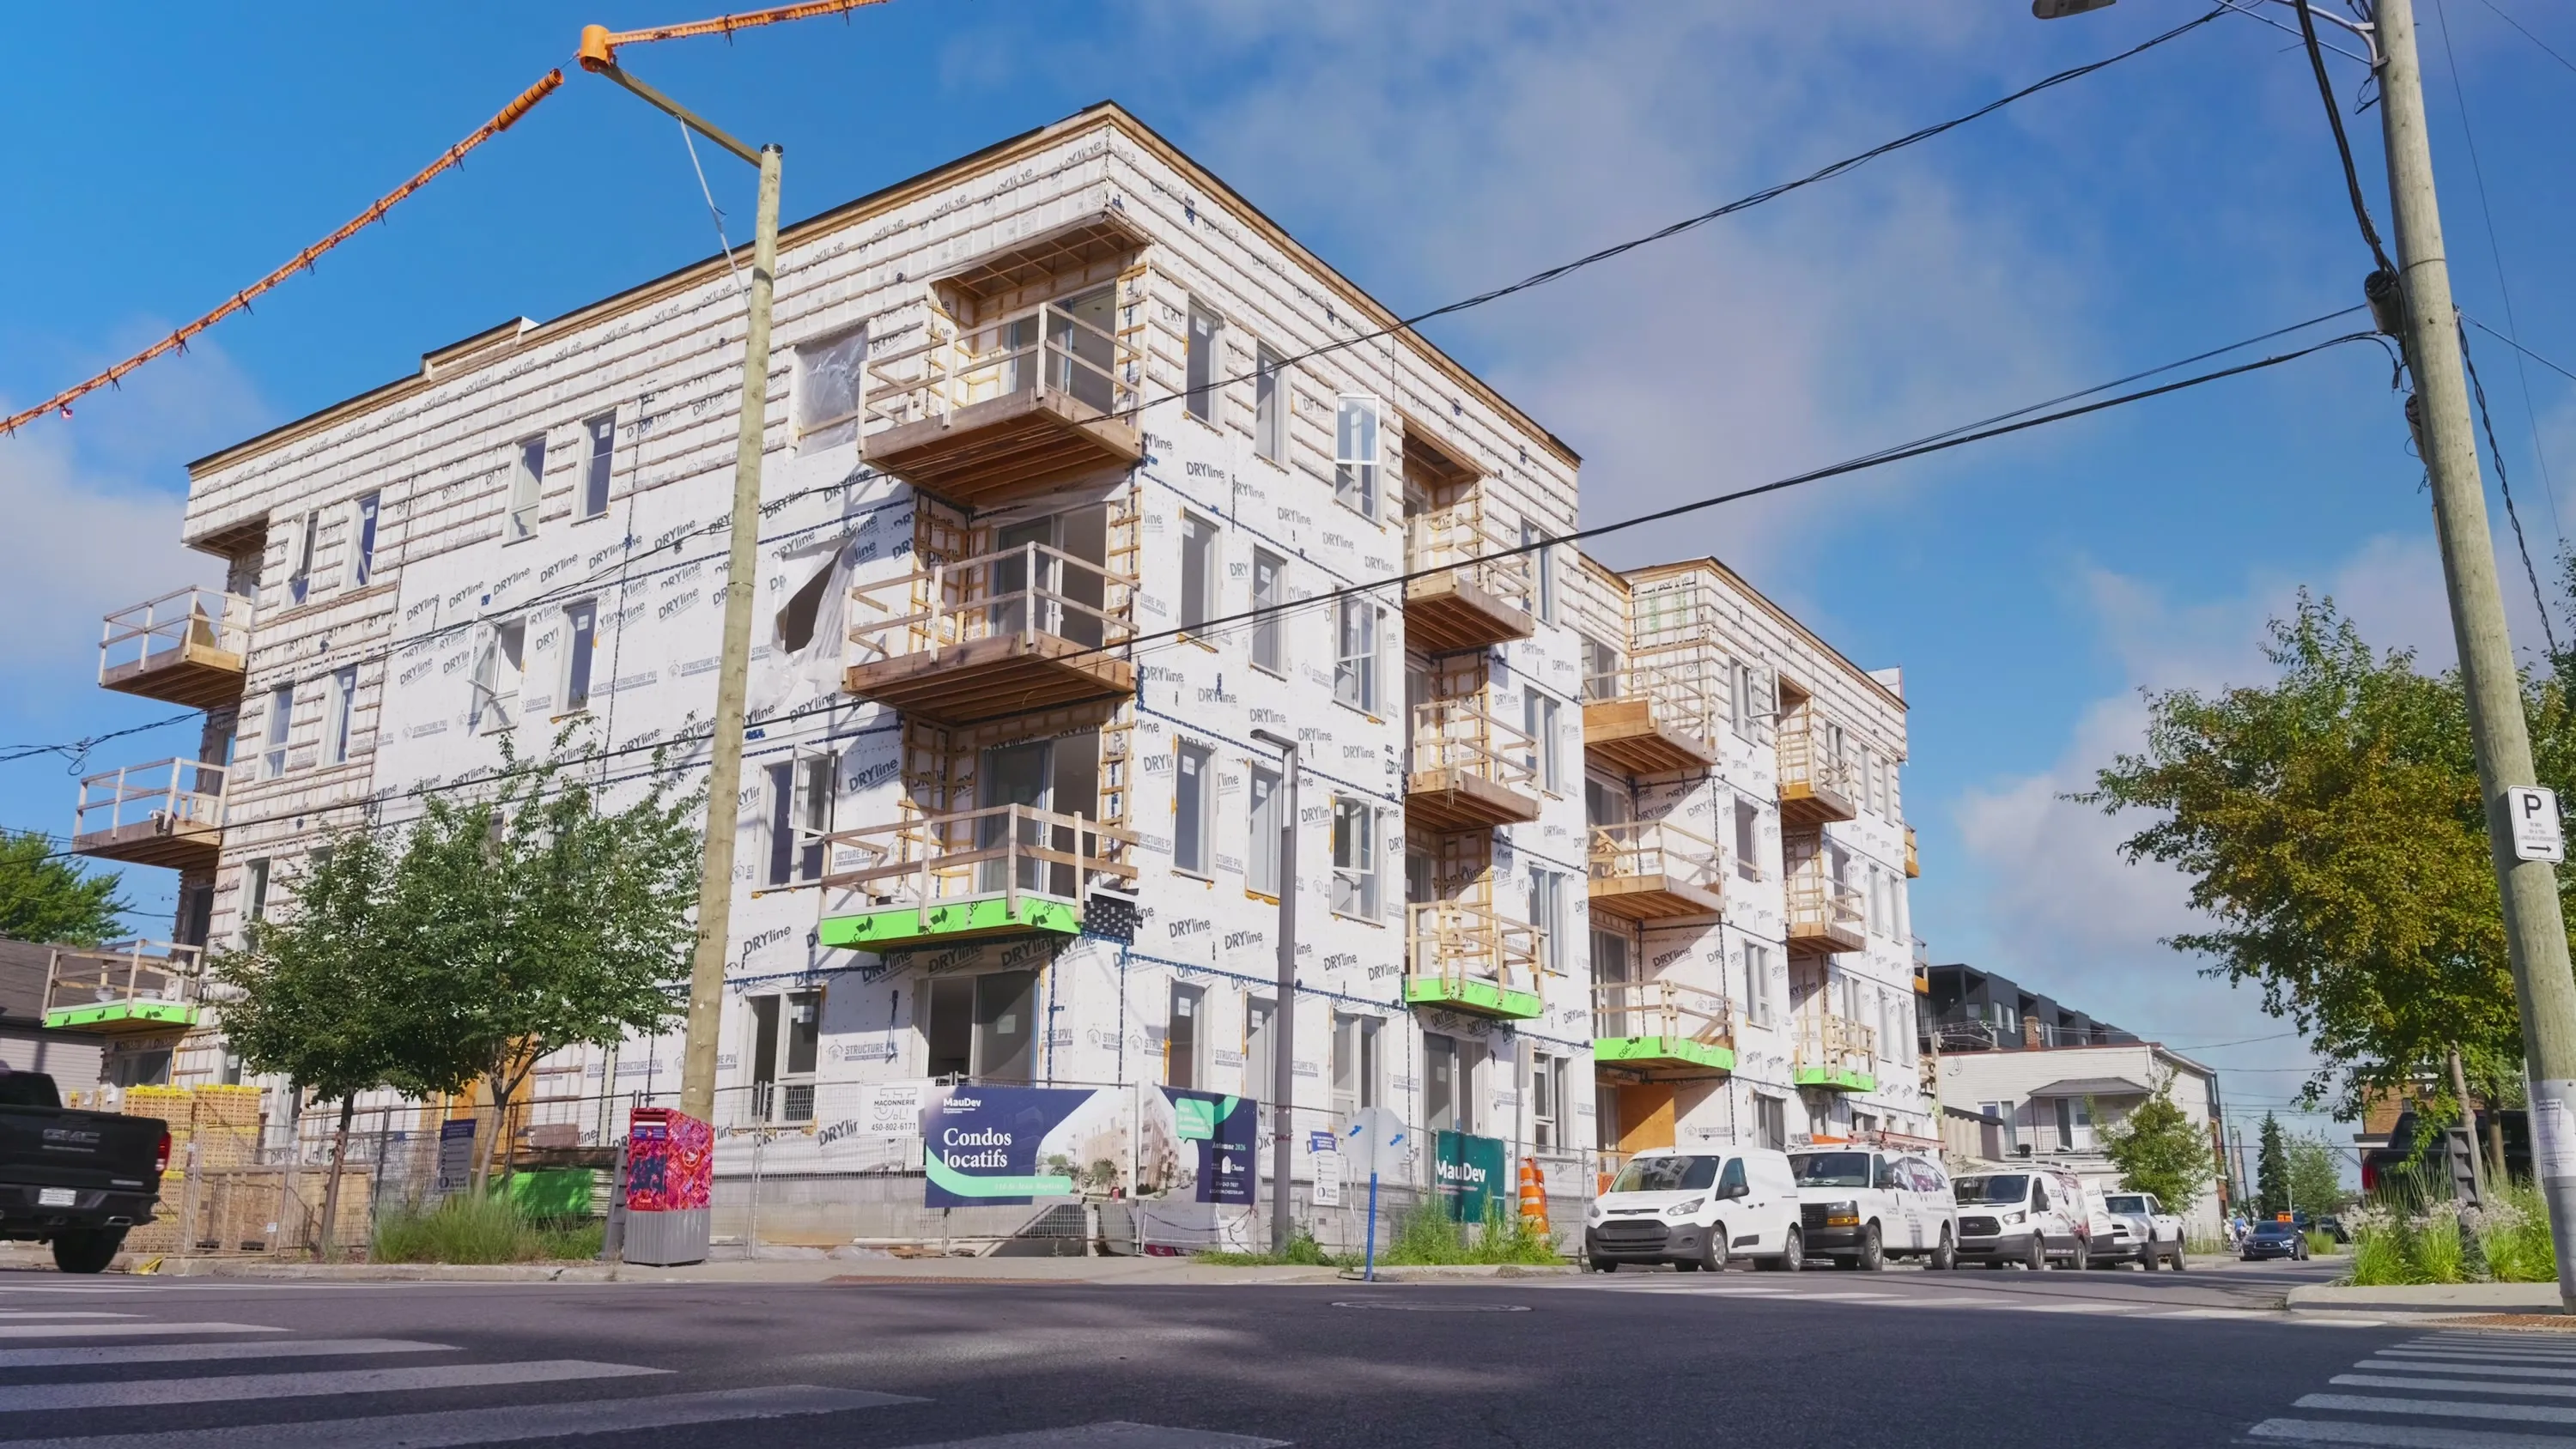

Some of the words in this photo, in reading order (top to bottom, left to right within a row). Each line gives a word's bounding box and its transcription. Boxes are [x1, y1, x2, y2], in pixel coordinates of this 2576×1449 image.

[1198, 688, 1237, 704] DRYine
[848, 758, 899, 792] DRYline
[2524, 794, 2542, 819] P
[1652, 947, 1692, 968] DRYline
[845, 1042, 884, 1057] STRUCTURE
[943, 1098, 981, 1107] MauDev
[872, 1123, 916, 1131] 450-802-6171
[943, 1128, 1012, 1146] Condos
[943, 1149, 1007, 1167] locatifs
[1436, 1161, 1485, 1183] MauDev
